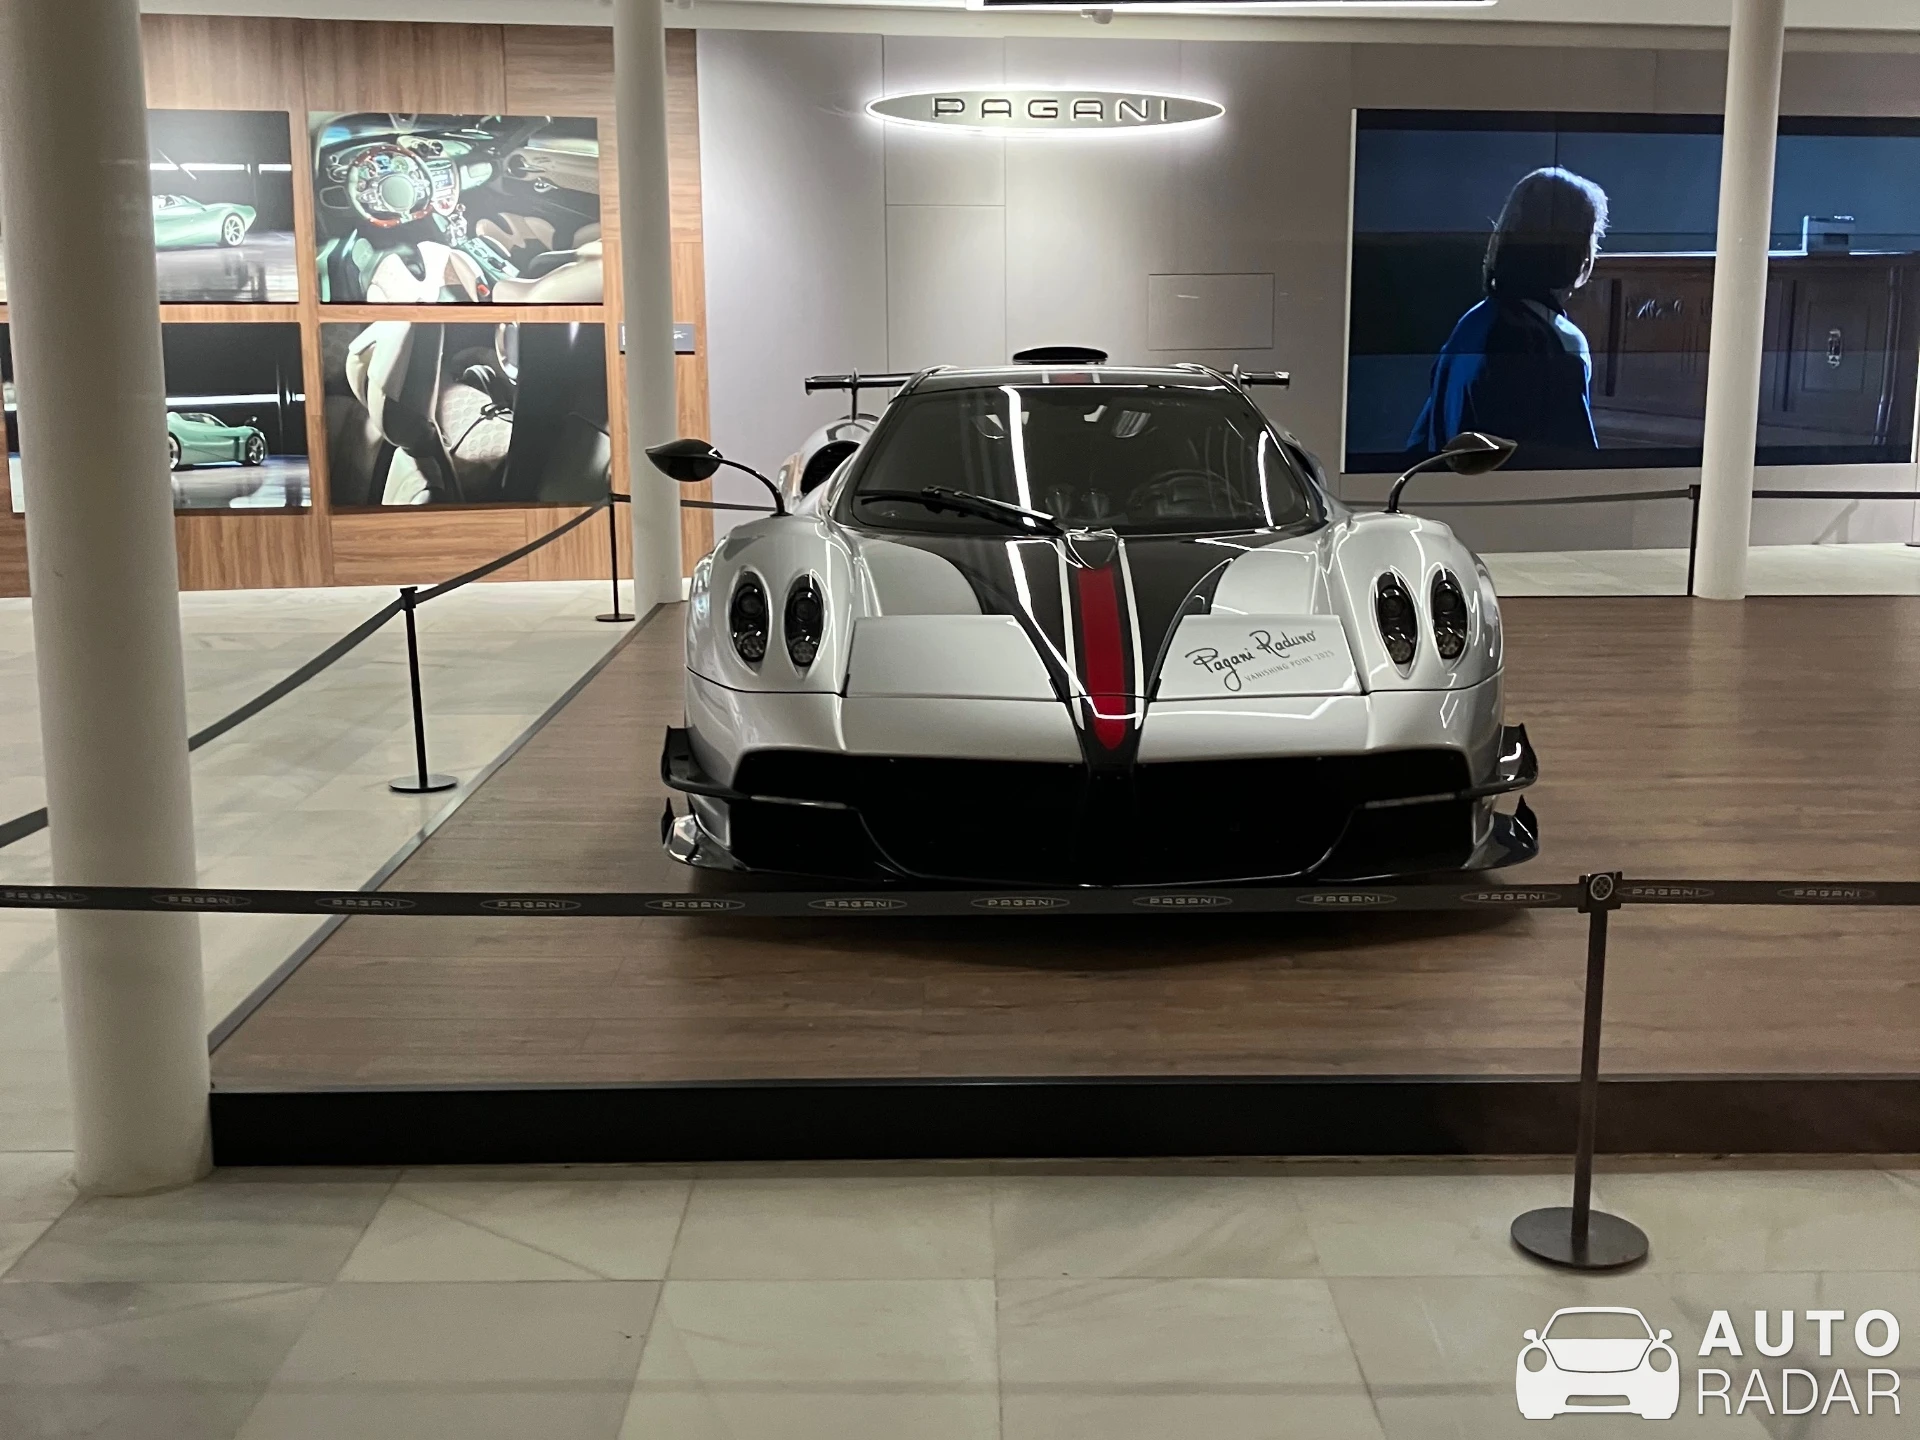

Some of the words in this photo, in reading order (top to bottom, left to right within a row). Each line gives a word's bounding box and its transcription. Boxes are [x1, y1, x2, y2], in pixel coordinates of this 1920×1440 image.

[931, 97, 1168, 121] PAGANI
[1185, 647, 1256, 692] Pagani
[1249, 630, 1316, 659] Raduno
[1244, 663, 1290, 682] VANISHING
[1291, 655, 1314, 669] POINT
[1315, 649, 1336, 661] 2025
[1478, 892, 1546, 901] PAGANI
[1632, 888, 1699, 897] PAGANI
[1794, 888, 1862, 898] PAGANI
[988, 899, 1054, 907] PAGANI
[1150, 897, 1217, 905] PAGANI
[1313, 894, 1380, 903] PAGANI
[497, 900, 566, 909] PAGANI
[662, 901, 730, 909] PAGANI
[825, 900, 893, 908] PAGANI
